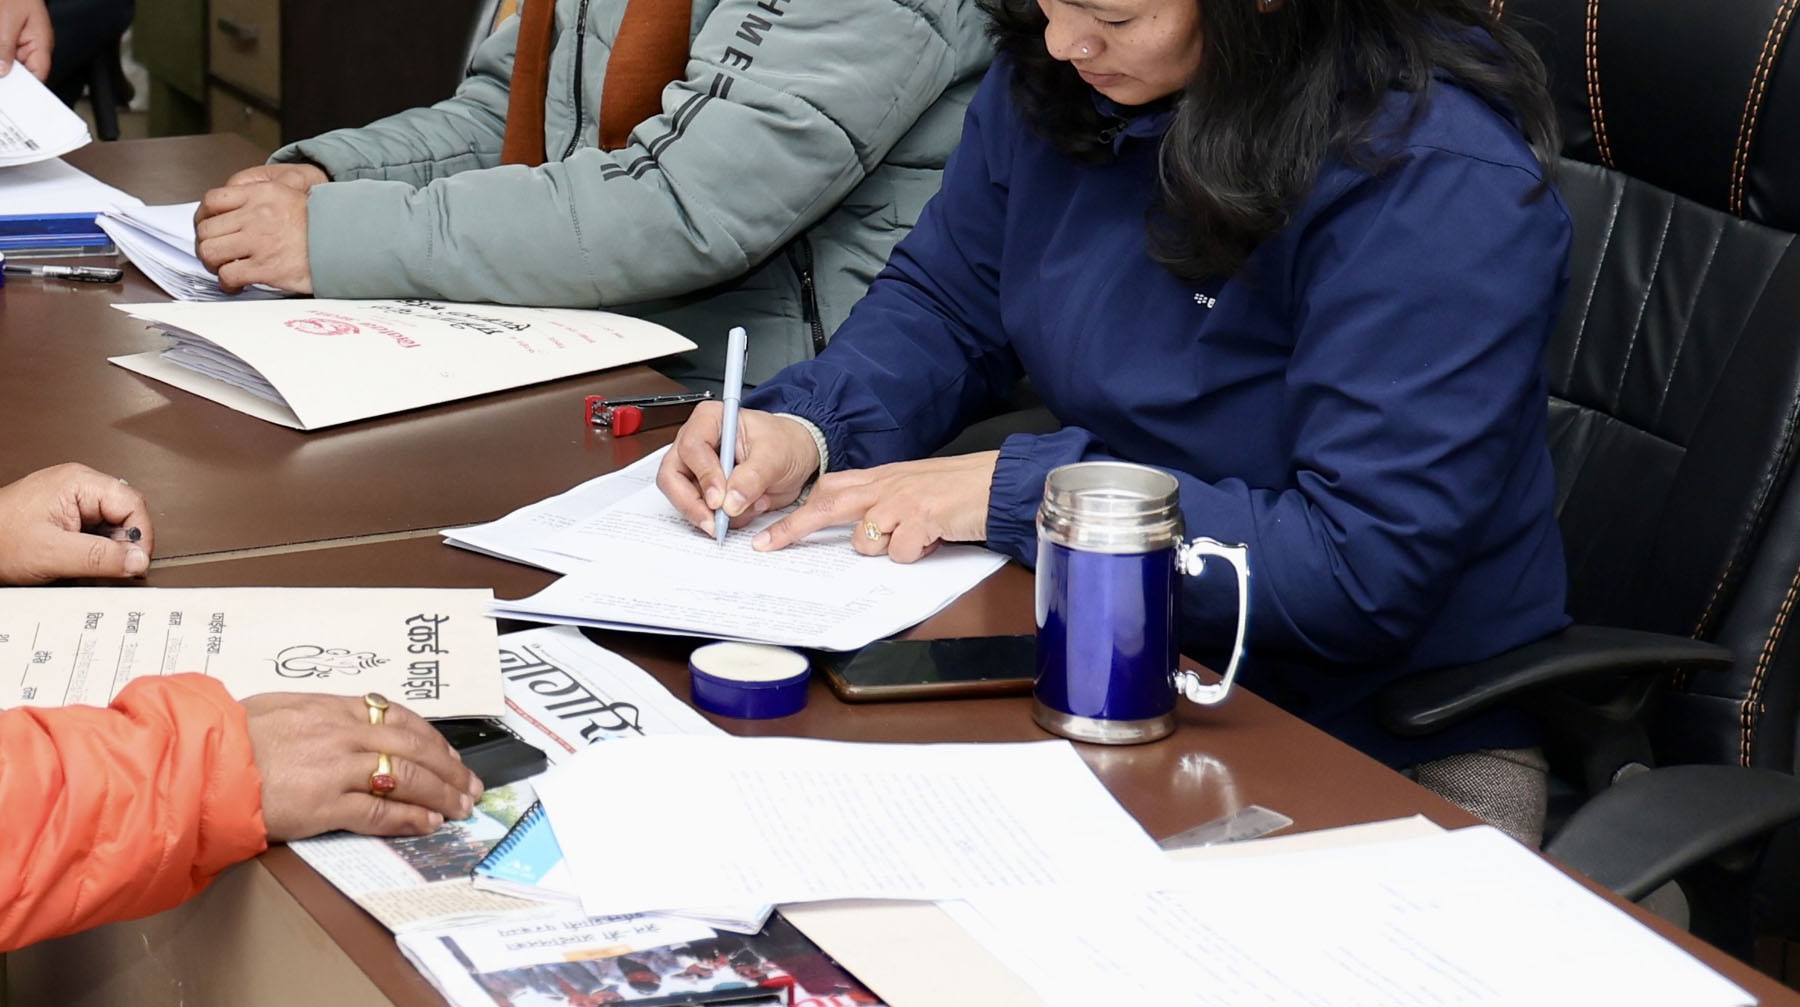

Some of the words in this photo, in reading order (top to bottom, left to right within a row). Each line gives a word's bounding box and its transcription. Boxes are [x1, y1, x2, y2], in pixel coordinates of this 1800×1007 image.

[84, 612, 104, 630] विषय
[168, 611, 183, 626] नाम
[405, 613, 450, 655] रेकर्ड
[401, 660, 450, 701] फाईल
[499, 644, 646, 745] नागरि
